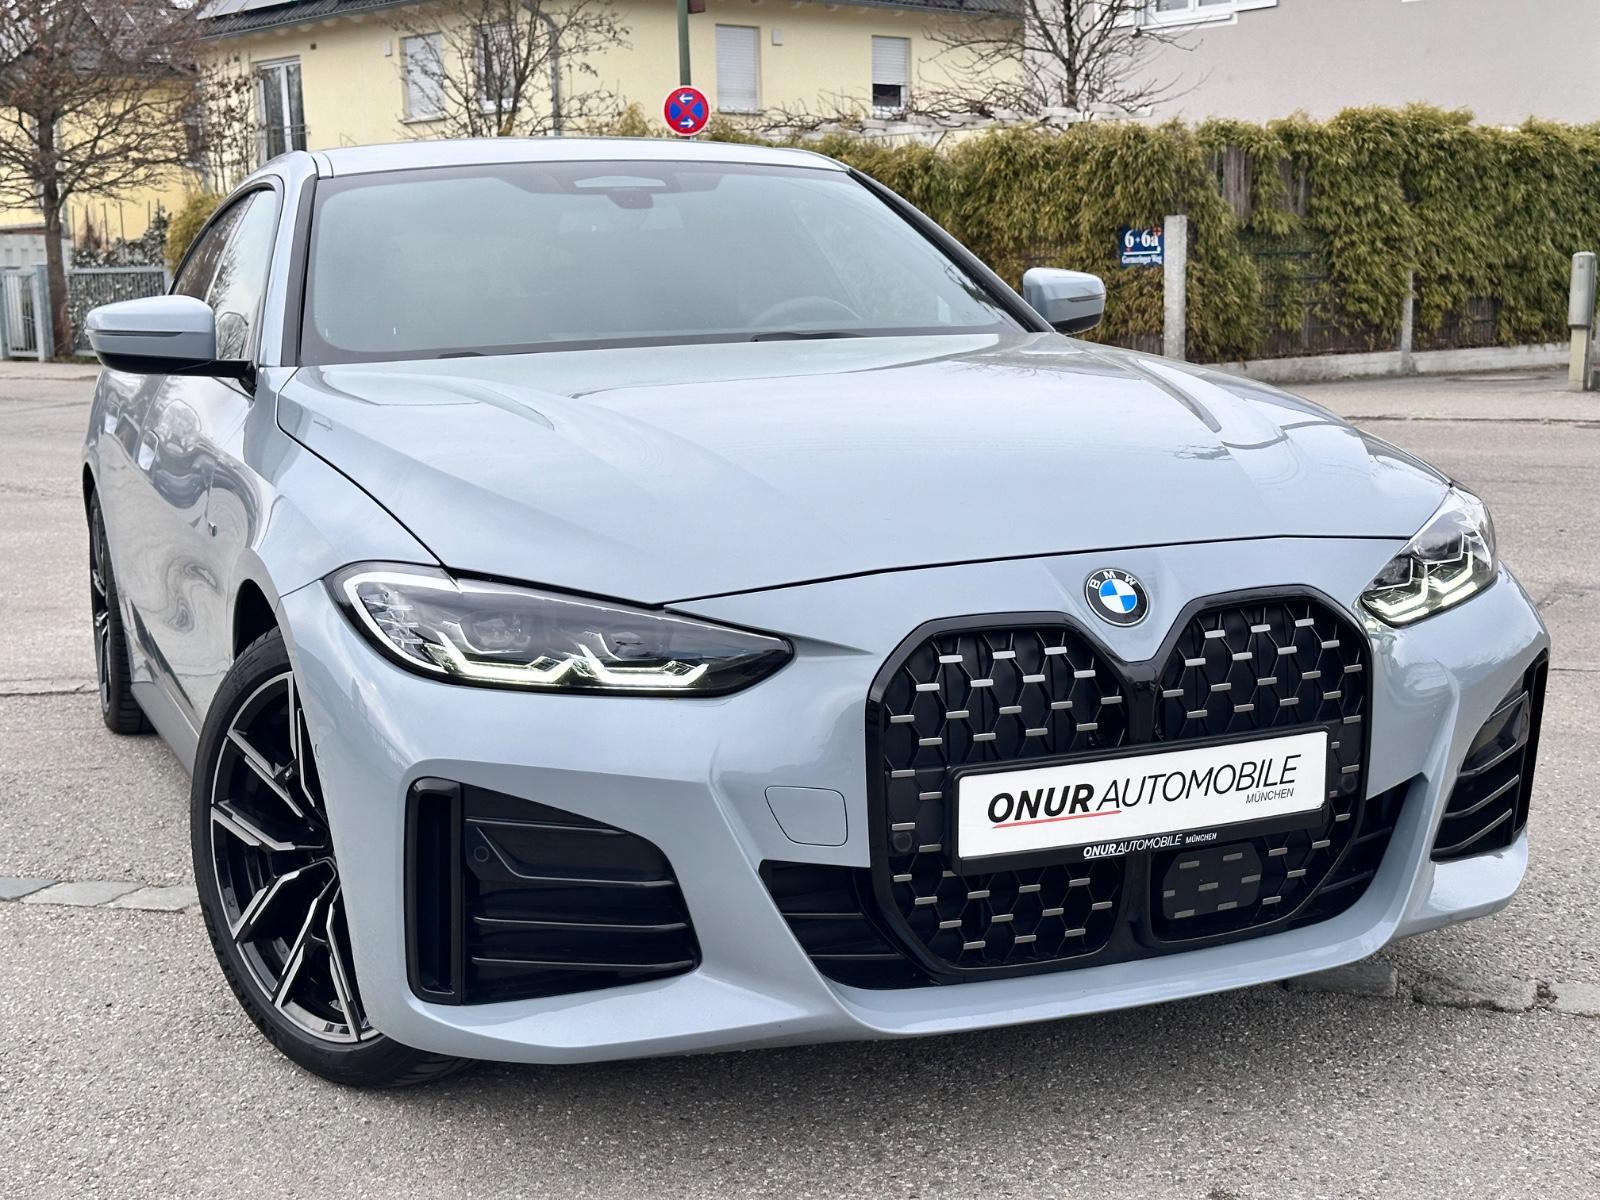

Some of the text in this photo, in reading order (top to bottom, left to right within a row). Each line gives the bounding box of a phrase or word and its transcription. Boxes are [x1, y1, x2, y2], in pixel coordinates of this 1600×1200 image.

[1089, 570, 1136, 590] BMW
[987, 754, 1302, 823] ONUR AUTOMOBILE
[1245, 787, 1295, 804] MÜNCHEN
[1083, 832, 1218, 858] ONUR AUTOMOBILE MÜNCHEN
